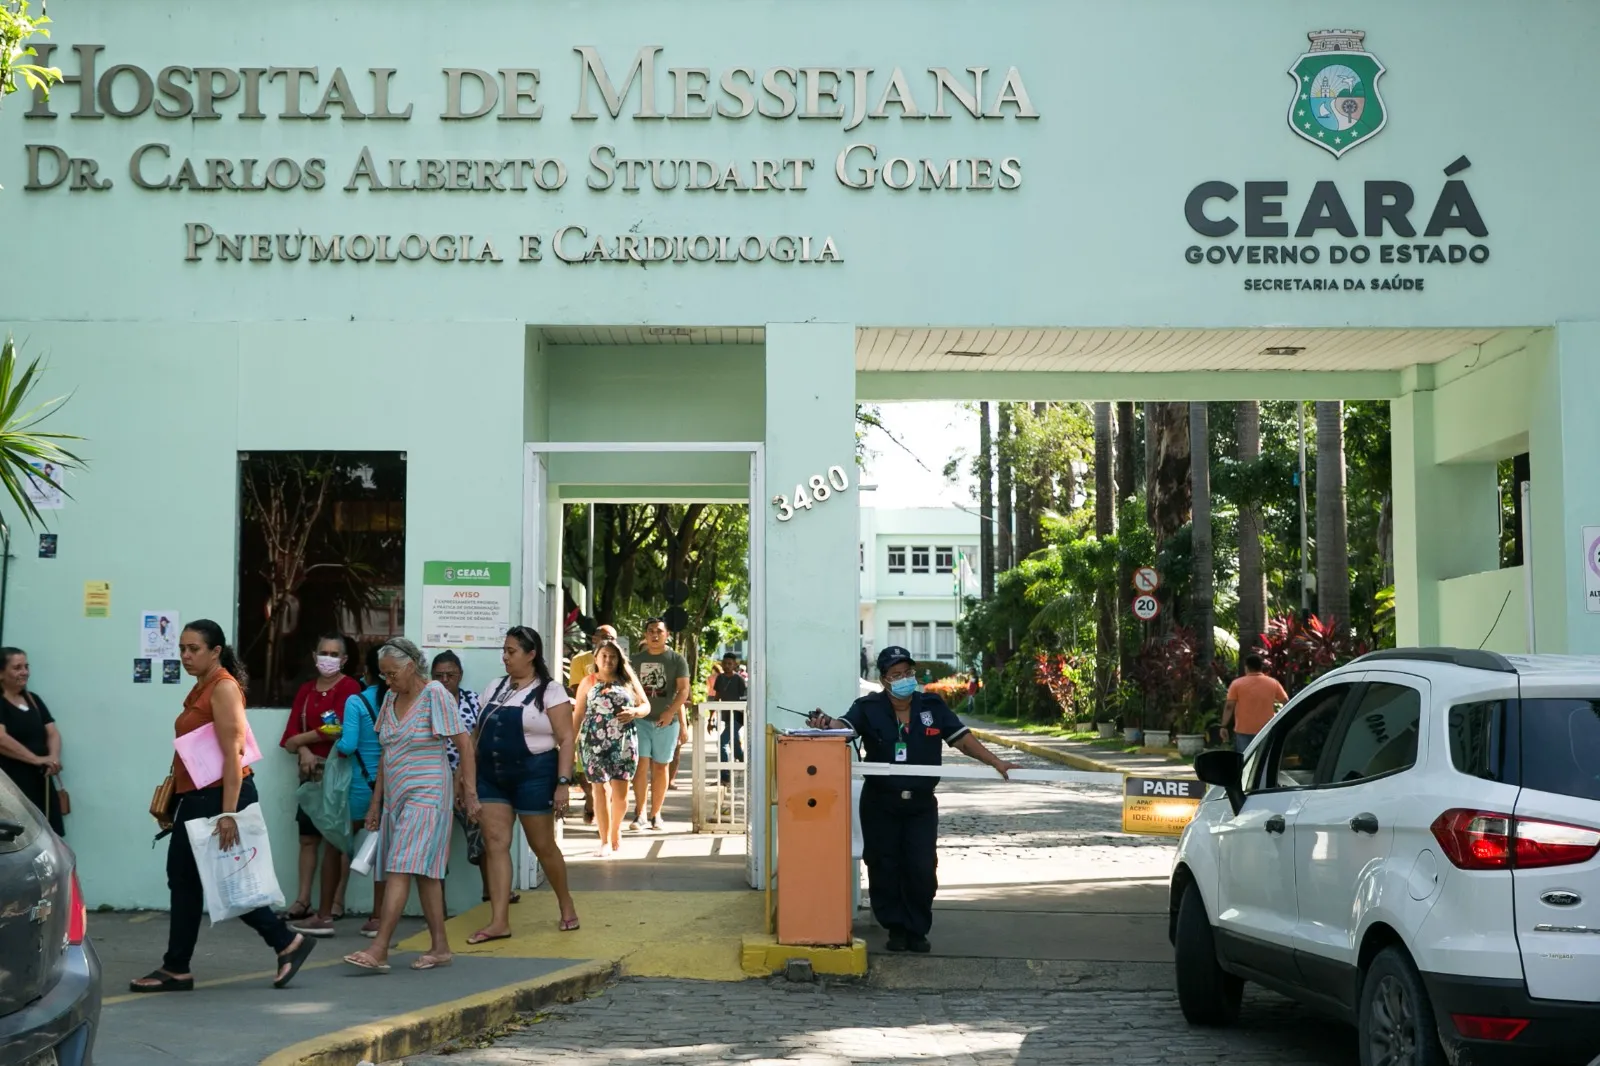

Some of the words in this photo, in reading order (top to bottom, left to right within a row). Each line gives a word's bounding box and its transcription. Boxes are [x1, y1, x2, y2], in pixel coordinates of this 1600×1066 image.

[23, 44, 413, 120] HOSPITAL
[440, 68, 544, 120] DE
[571, 45, 1040, 131] MESSEJANA
[24, 144, 113, 190] DR.
[129, 143, 326, 190] CARLOS
[343, 145, 568, 190] ALBERTO
[587, 144, 814, 190] STUDART
[836, 144, 1022, 190] GOMES
[1184, 155, 1489, 237] CEARÁ
[184, 222, 503, 262] PNEUMOLOGIA
[519, 234, 543, 261] E
[552, 225, 844, 263] CARDIOLOGIA
[1185, 245, 1320, 264] GOVERNO
[1330, 245, 1370, 264] DO
[1380, 244, 1490, 264] ESTADO
[1244, 278, 1339, 291] SECRETARIA
[1344, 279, 1366, 291] DA
[1370, 274, 1424, 291] SAÚDE
[772, 465, 849, 522] 3480
[457, 567, 490, 576] CEARÁ
[1138, 600, 1155, 611] 20
[1143, 780, 1189, 796] PARE
